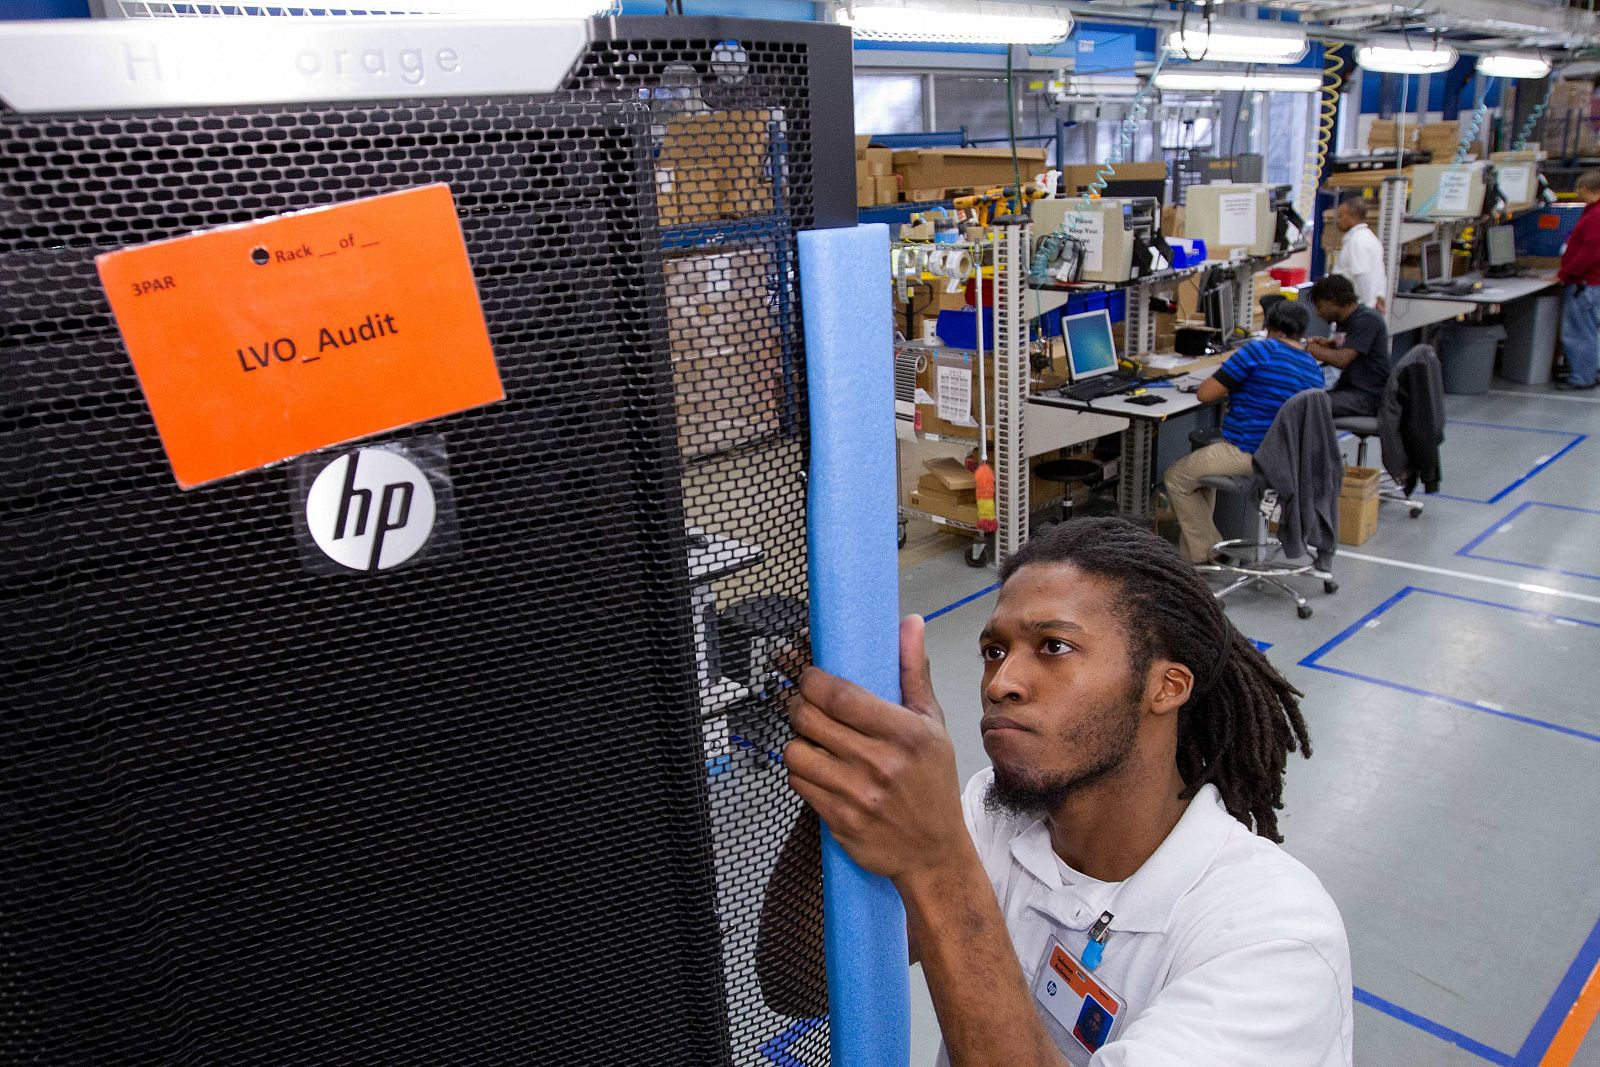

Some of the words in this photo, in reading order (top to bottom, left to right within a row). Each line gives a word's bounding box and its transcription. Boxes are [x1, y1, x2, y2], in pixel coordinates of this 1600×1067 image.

[275, 244, 313, 263] Rack
[338, 233, 355, 249] of
[131, 275, 176, 297] 3PAR
[236, 312, 399, 372] LVO_Audit
[329, 449, 415, 571] hp
